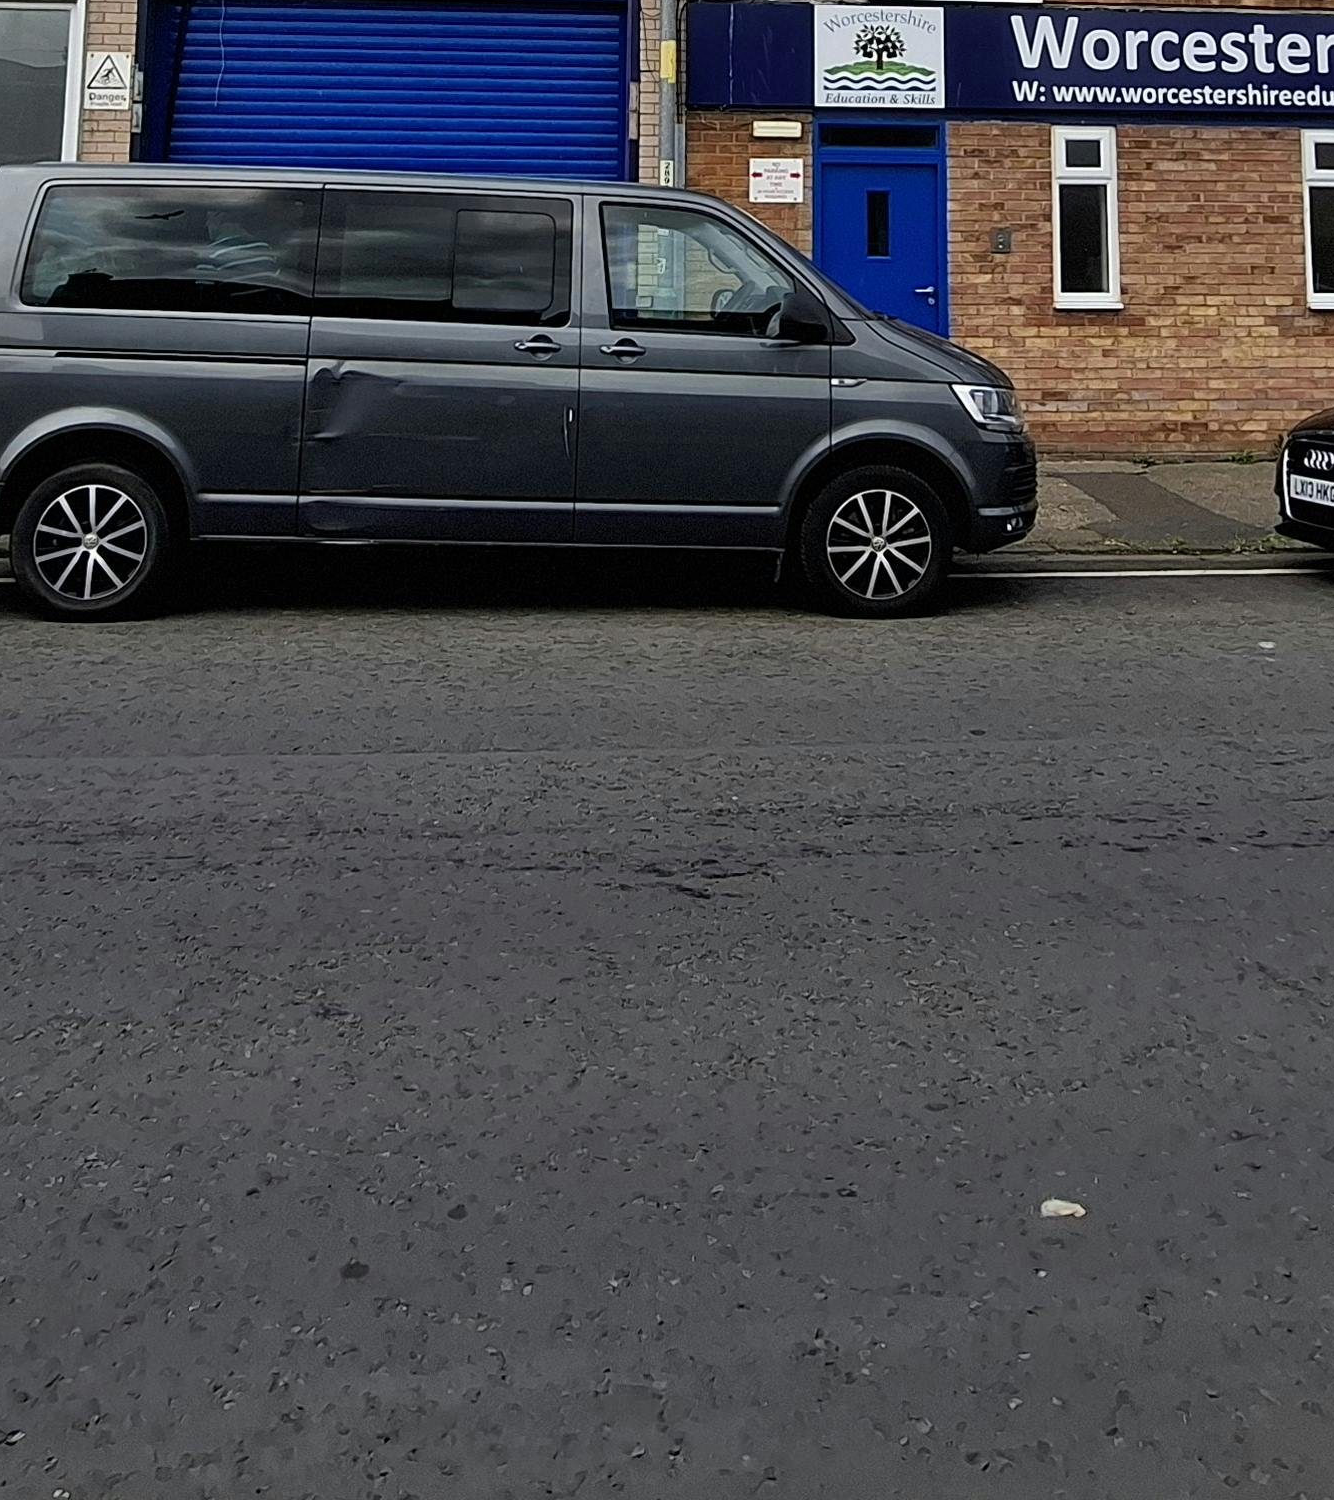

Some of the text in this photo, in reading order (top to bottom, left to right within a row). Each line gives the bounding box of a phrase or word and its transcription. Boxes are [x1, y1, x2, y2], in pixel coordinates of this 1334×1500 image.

[823, 8, 937, 35] Worcestershire
[89, 92, 126, 102] Danger
[825, 92, 936, 105] Education & Skills
[1012, 80, 1046, 103] W:
